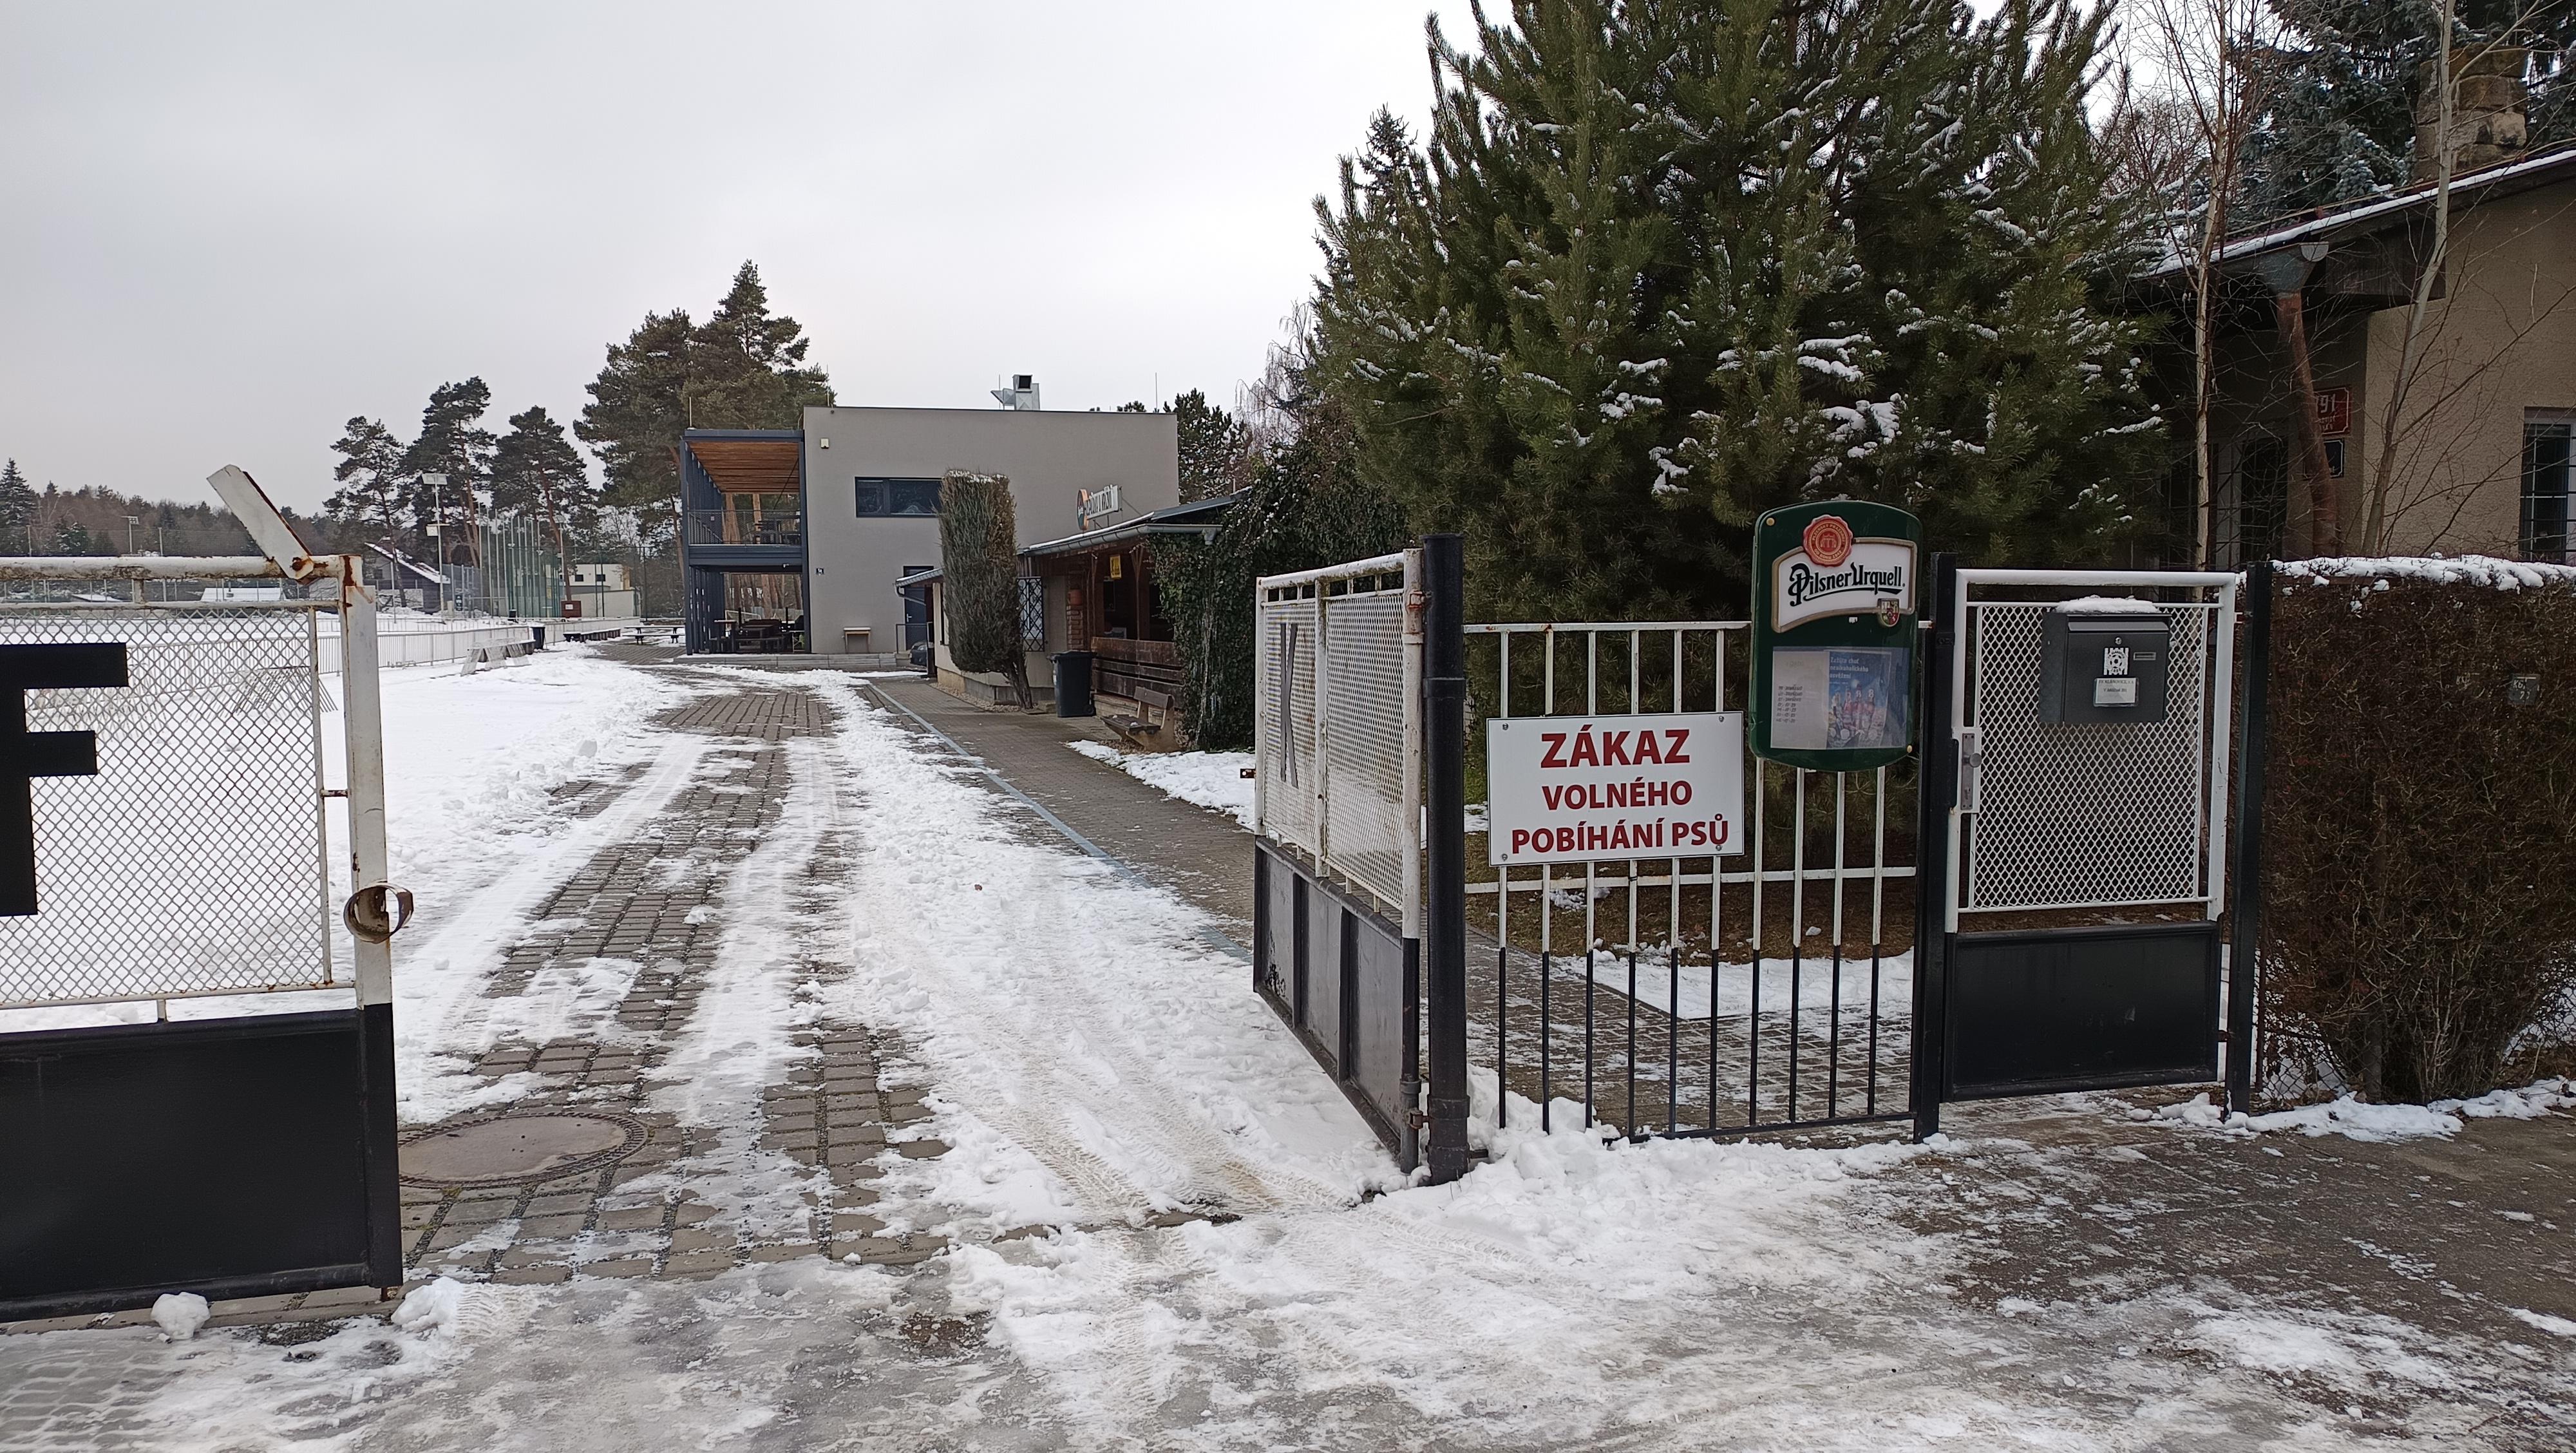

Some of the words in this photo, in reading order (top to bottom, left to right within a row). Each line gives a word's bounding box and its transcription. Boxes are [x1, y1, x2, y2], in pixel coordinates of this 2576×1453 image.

[2318, 394, 2336, 413] 91
[1788, 563, 1852, 607] Pilsner
[1280, 622, 1299, 789] K
[1540, 724, 1690, 768] ZÁKAZ
[1542, 776, 1692, 810] VOLNÉHO
[1511, 817, 1665, 854] POBÍHÁNÍ
[1672, 813, 1728, 847] PSŮ
